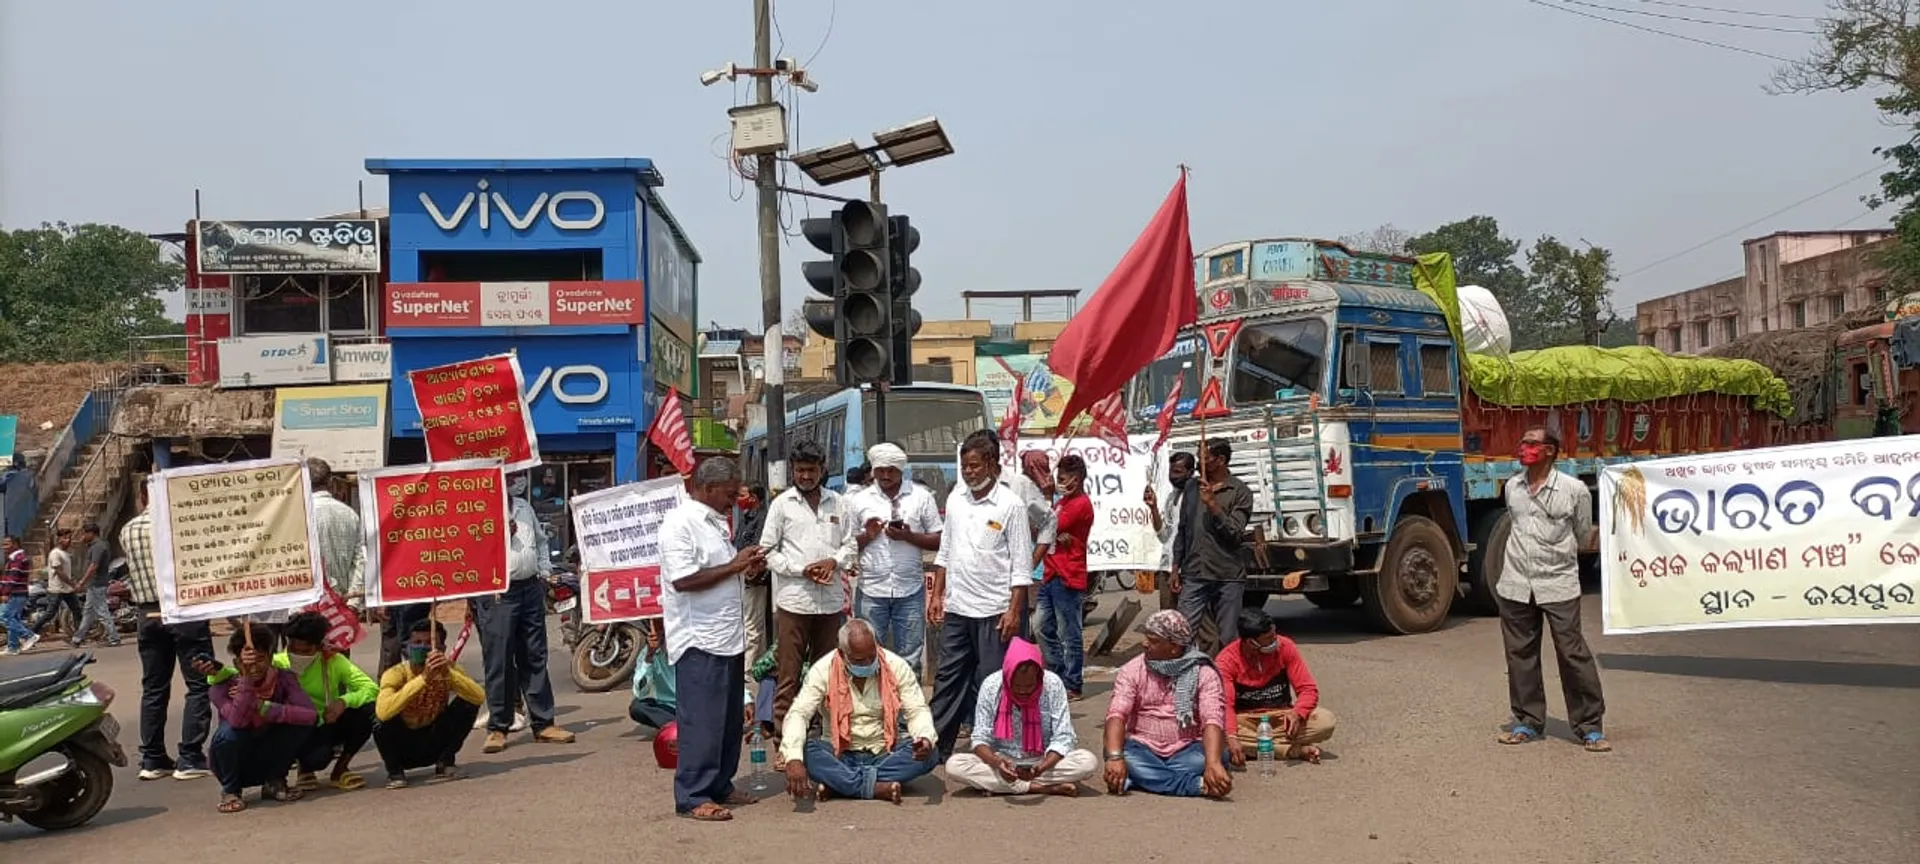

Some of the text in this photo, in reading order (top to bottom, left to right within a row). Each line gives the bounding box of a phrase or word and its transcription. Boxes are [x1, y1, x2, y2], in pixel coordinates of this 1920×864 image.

[418, 178, 605, 230] vivo
[332, 348, 390, 365] Amway
[1652, 480, 1825, 536] ଭାରତ
[180, 573, 309, 600] CENTRAL TRADE UNIONS
[1803, 582, 1915, 611] ଜୟପୁର
